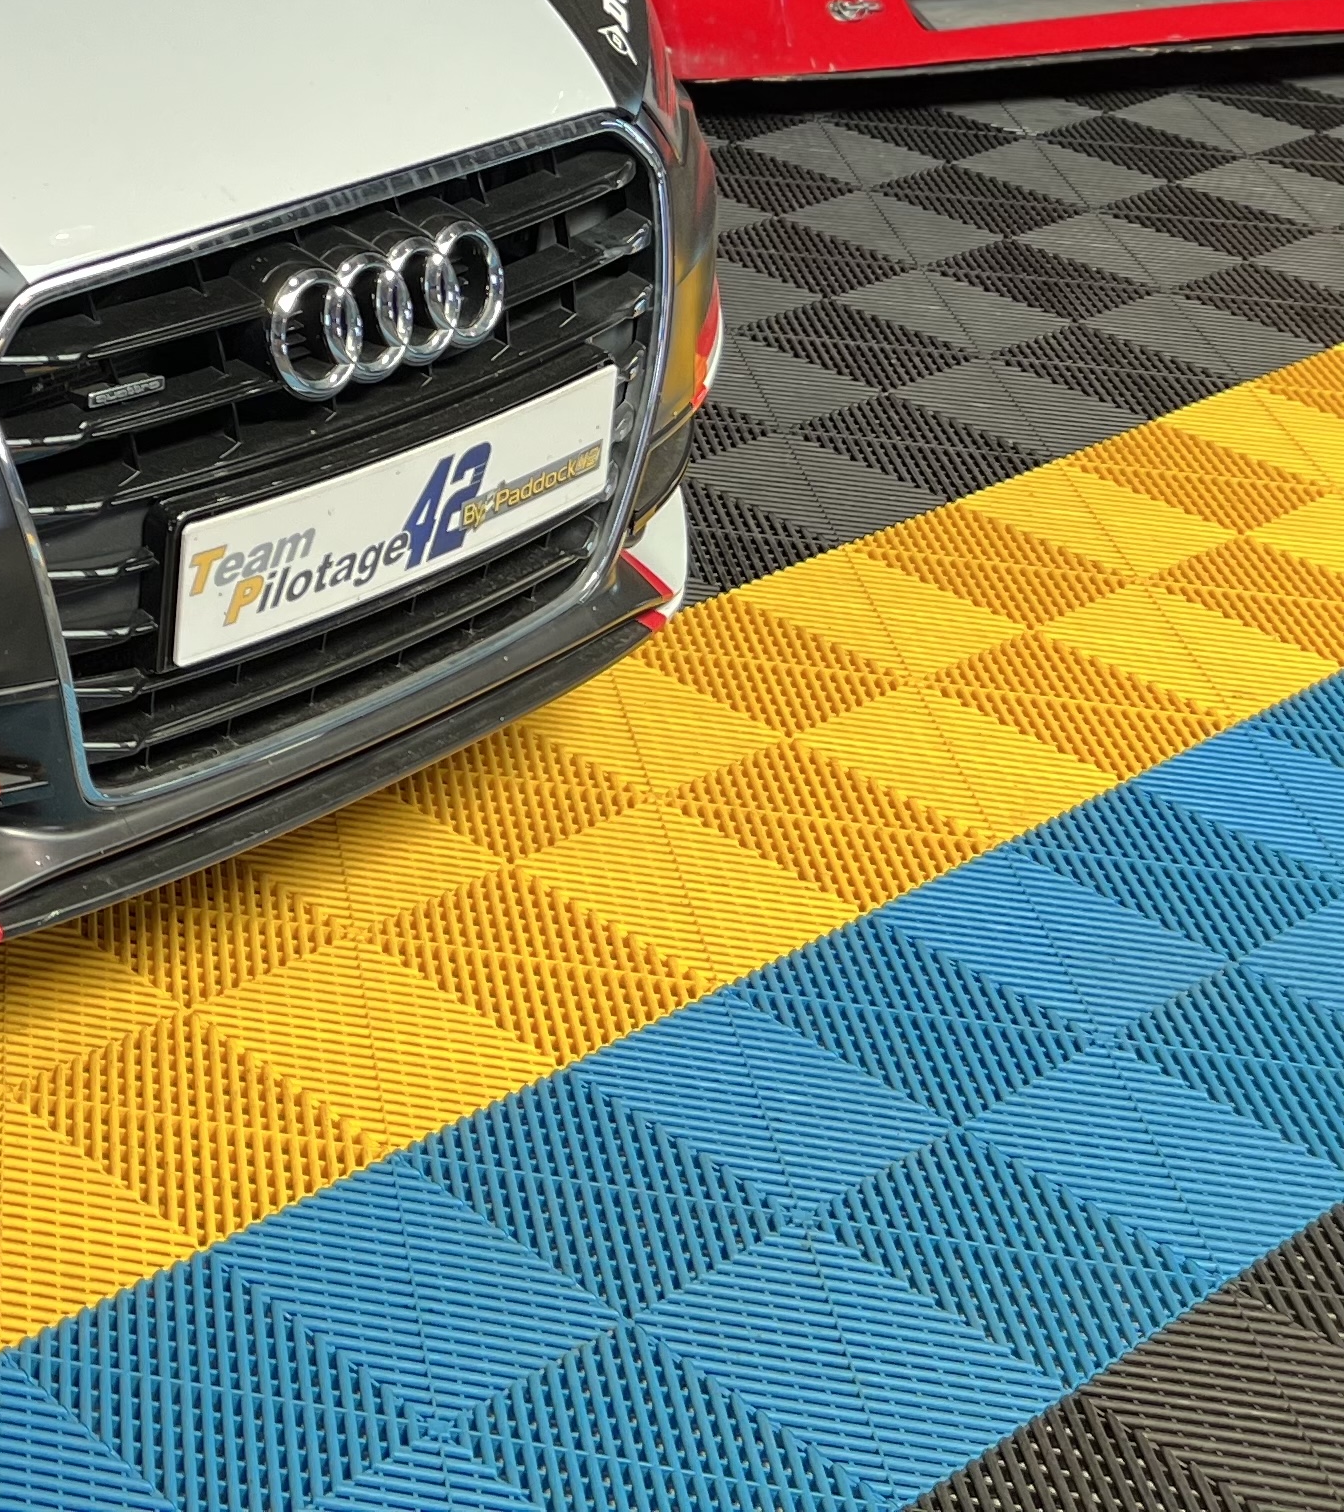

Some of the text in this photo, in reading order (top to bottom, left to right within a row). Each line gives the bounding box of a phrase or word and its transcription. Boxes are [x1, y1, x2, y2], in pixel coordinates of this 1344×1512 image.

[189, 527, 316, 597] Team
[223, 531, 411, 628] Pilotage
[402, 440, 492, 571] 42
